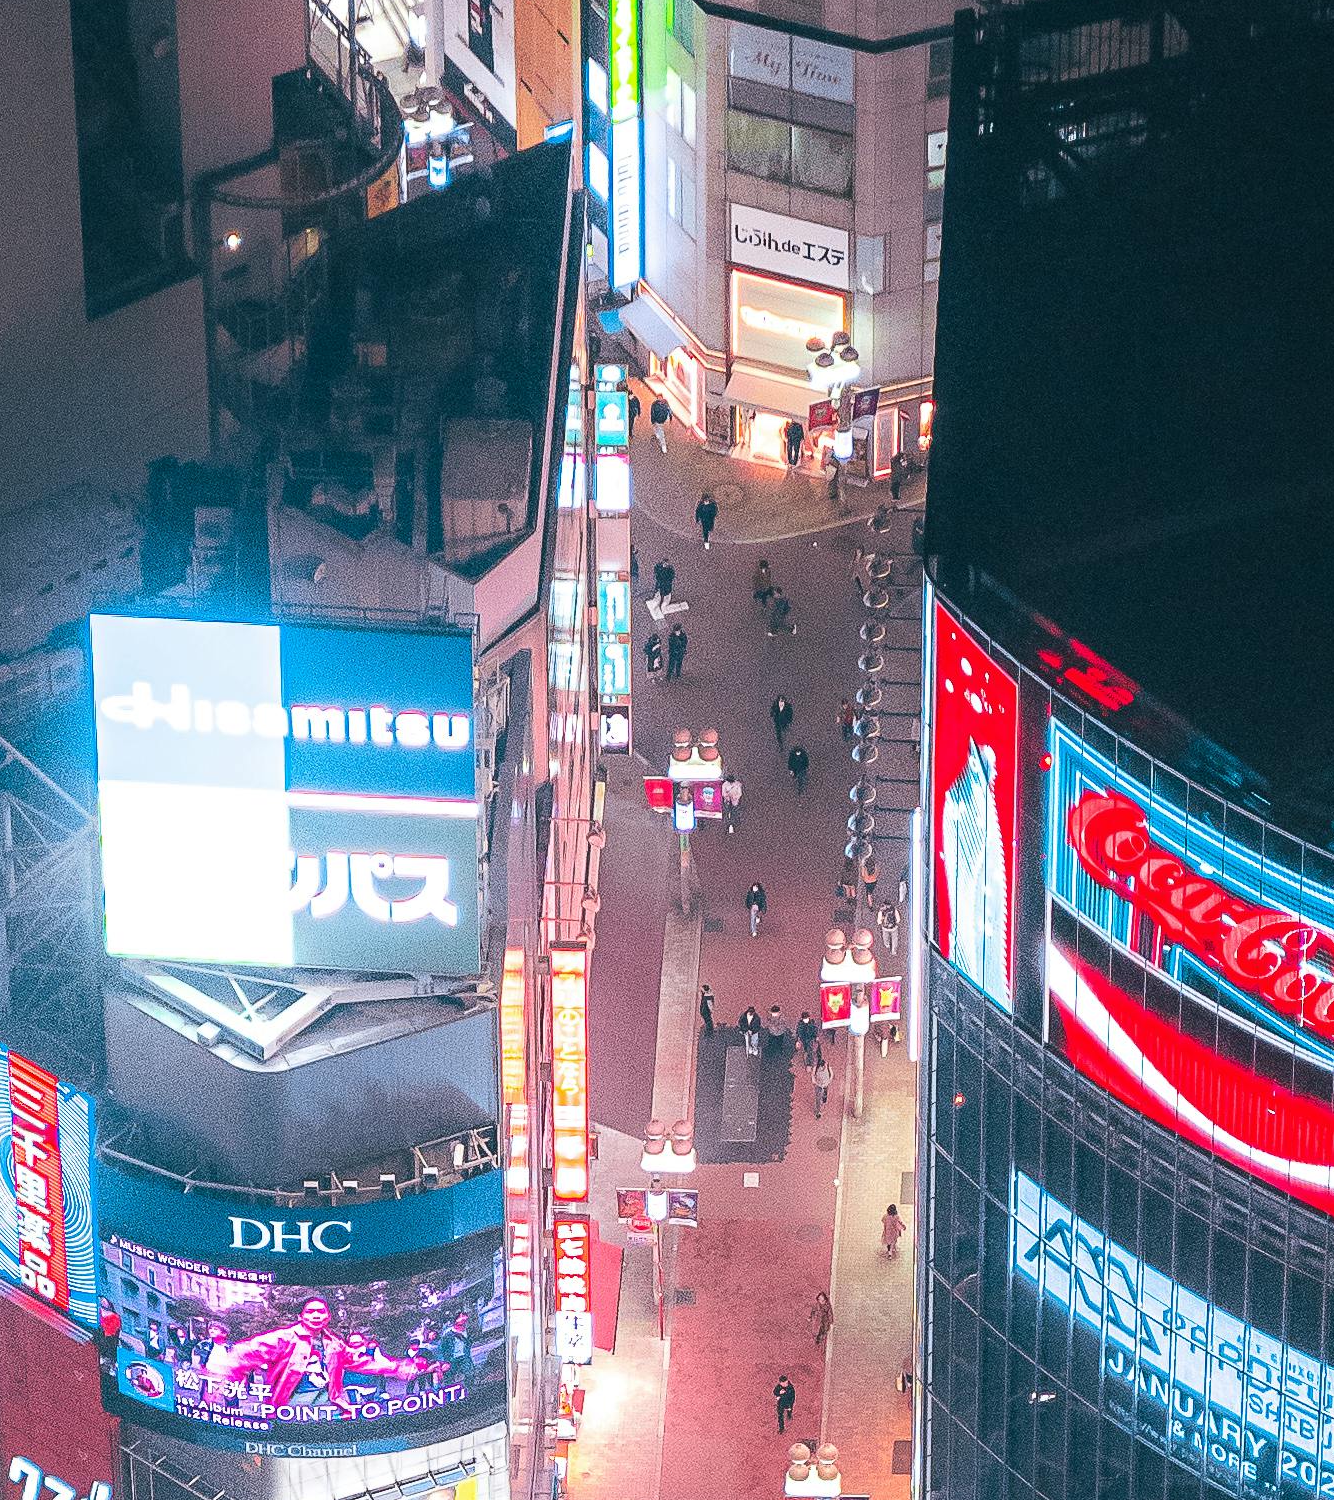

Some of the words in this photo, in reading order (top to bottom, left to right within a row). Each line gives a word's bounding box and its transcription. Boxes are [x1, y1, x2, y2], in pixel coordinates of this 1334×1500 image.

[9, 1053, 57, 1301] 三千里薬品
[229, 1215, 353, 1255] DHC
[119, 1237, 156, 1262] MUSIC
[158, 1252, 210, 1275] WONDER
[175, 1404, 210, 1421] 11.23
[212, 1412, 269, 1431] Release
[199, 1399, 244, 1417] Album
[347, 1402, 384, 1422] TO
[1107, 1351, 1269, 1456] JANUARY
[245, 1441, 284, 1458] DHC
[286, 1440, 358, 1459] Channel
[1193, 1429, 1258, 1480] MORE
